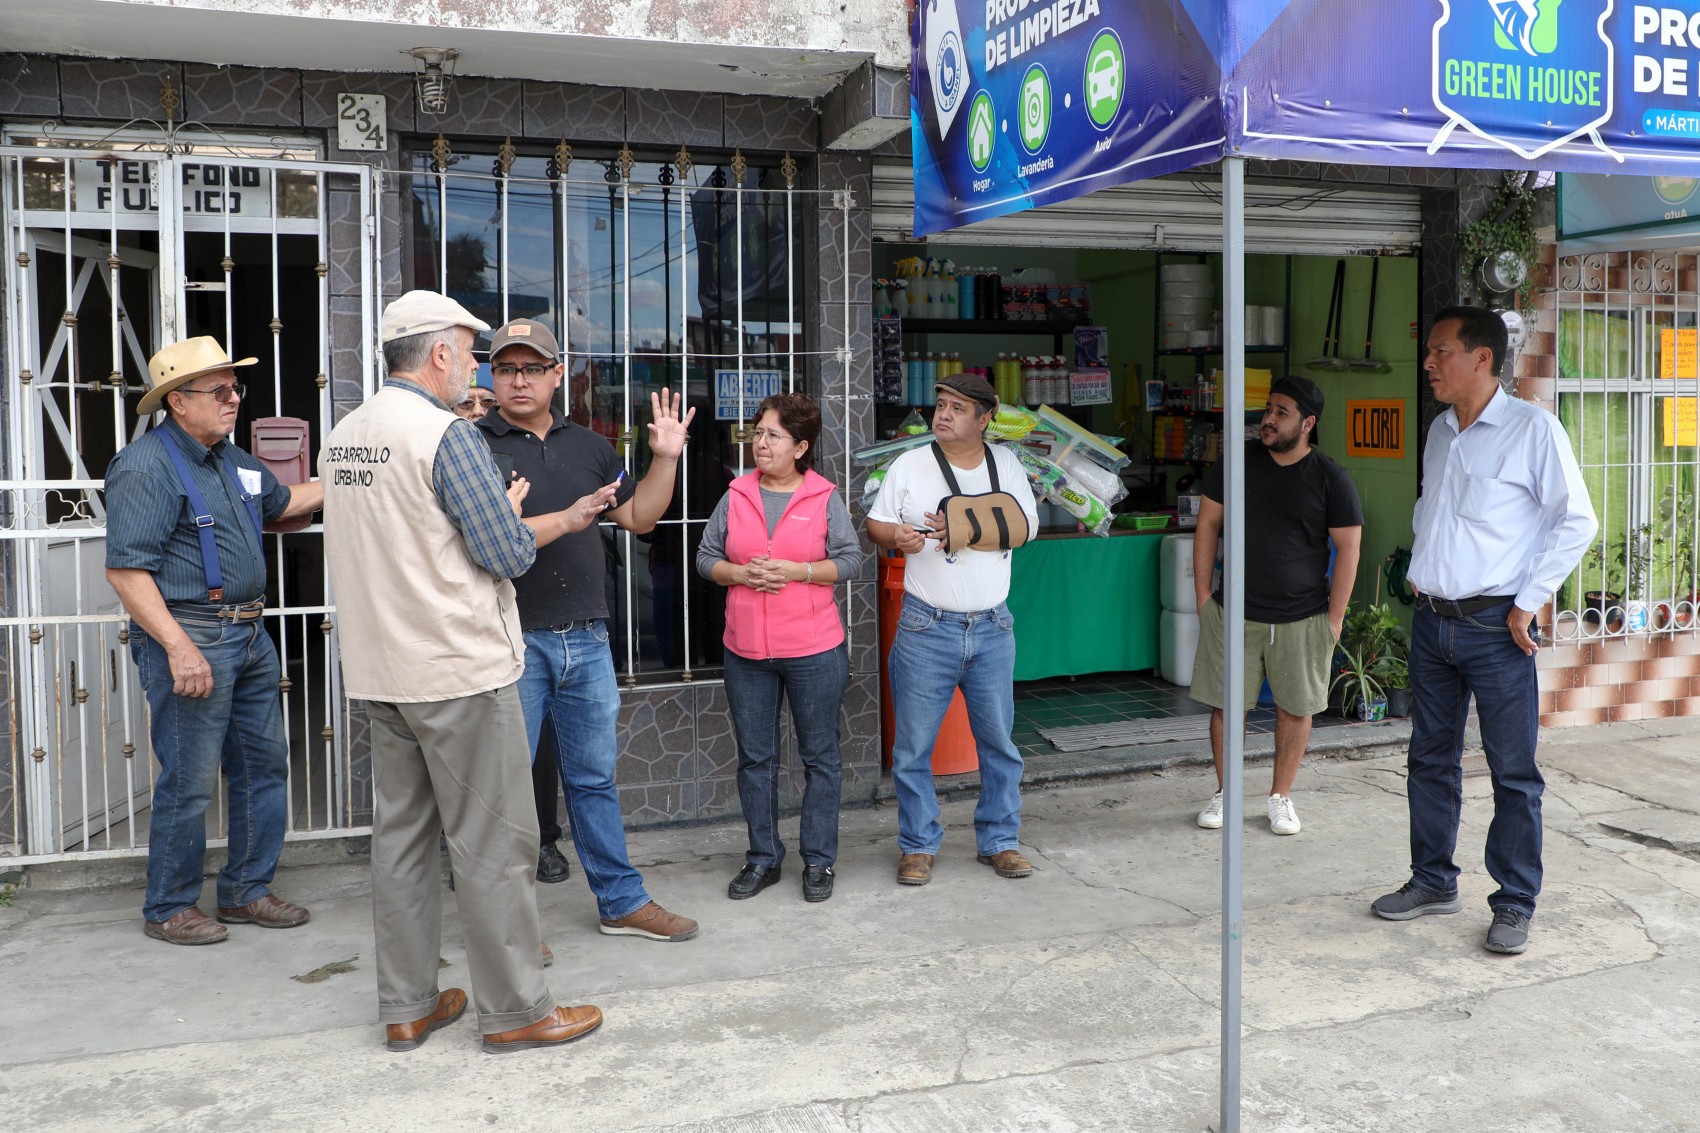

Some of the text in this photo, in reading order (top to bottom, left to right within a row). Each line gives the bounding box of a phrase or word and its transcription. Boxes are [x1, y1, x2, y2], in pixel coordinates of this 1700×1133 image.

[985, 0, 1101, 72] DE LIMPIEZA
[1445, 58, 1601, 107] GREEN HOUSE
[1633, 54, 1688, 96] DE
[96, 160, 260, 187] TELFONO
[1017, 154, 1055, 178] Lavandería
[972, 178, 991, 193] Hogar
[720, 374, 779, 397] ABERTO
[1353, 407, 1400, 449] CLORO
[326, 446, 390, 464] DESARROLLO
[334, 469, 373, 487] URBANO
